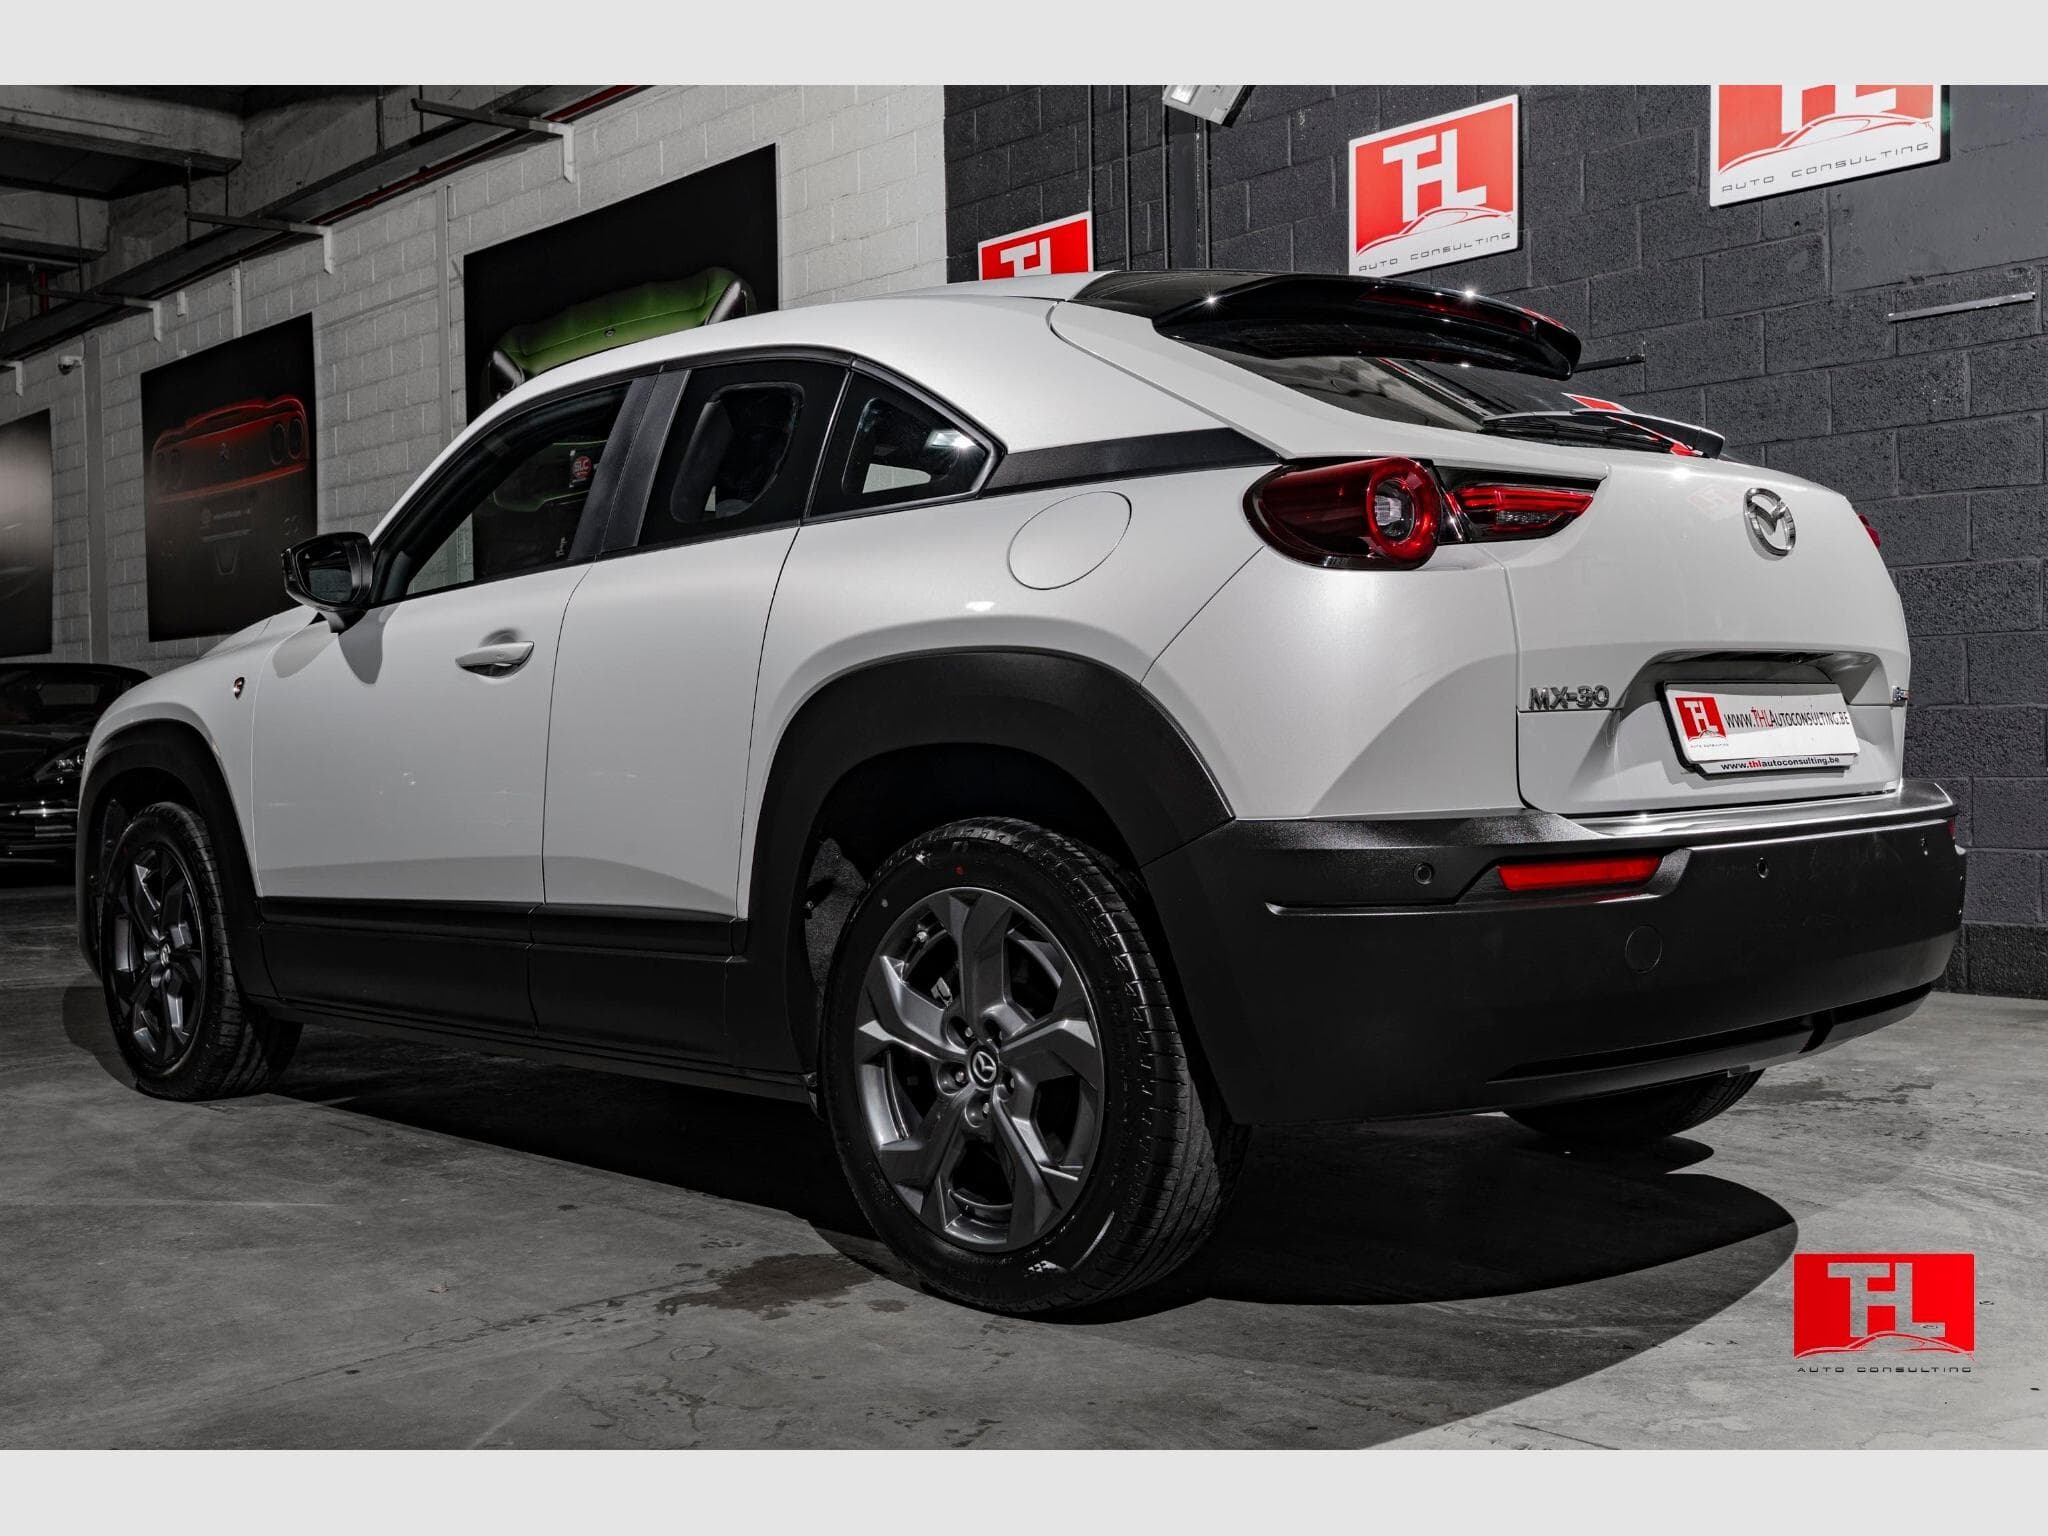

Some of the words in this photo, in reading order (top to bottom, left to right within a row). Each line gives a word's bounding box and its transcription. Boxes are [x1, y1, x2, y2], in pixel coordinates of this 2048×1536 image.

[1383, 128, 1487, 223] THL
[1722, 176, 1774, 192] AUTO
[1791, 142, 1929, 178] CONSULTING
[1359, 258, 1398, 272] AUTO
[1410, 232, 1511, 261] CONSULTING
[1528, 685, 1610, 711] MX-30
[1721, 756, 1840, 771] www.thlautoconsulting.be
